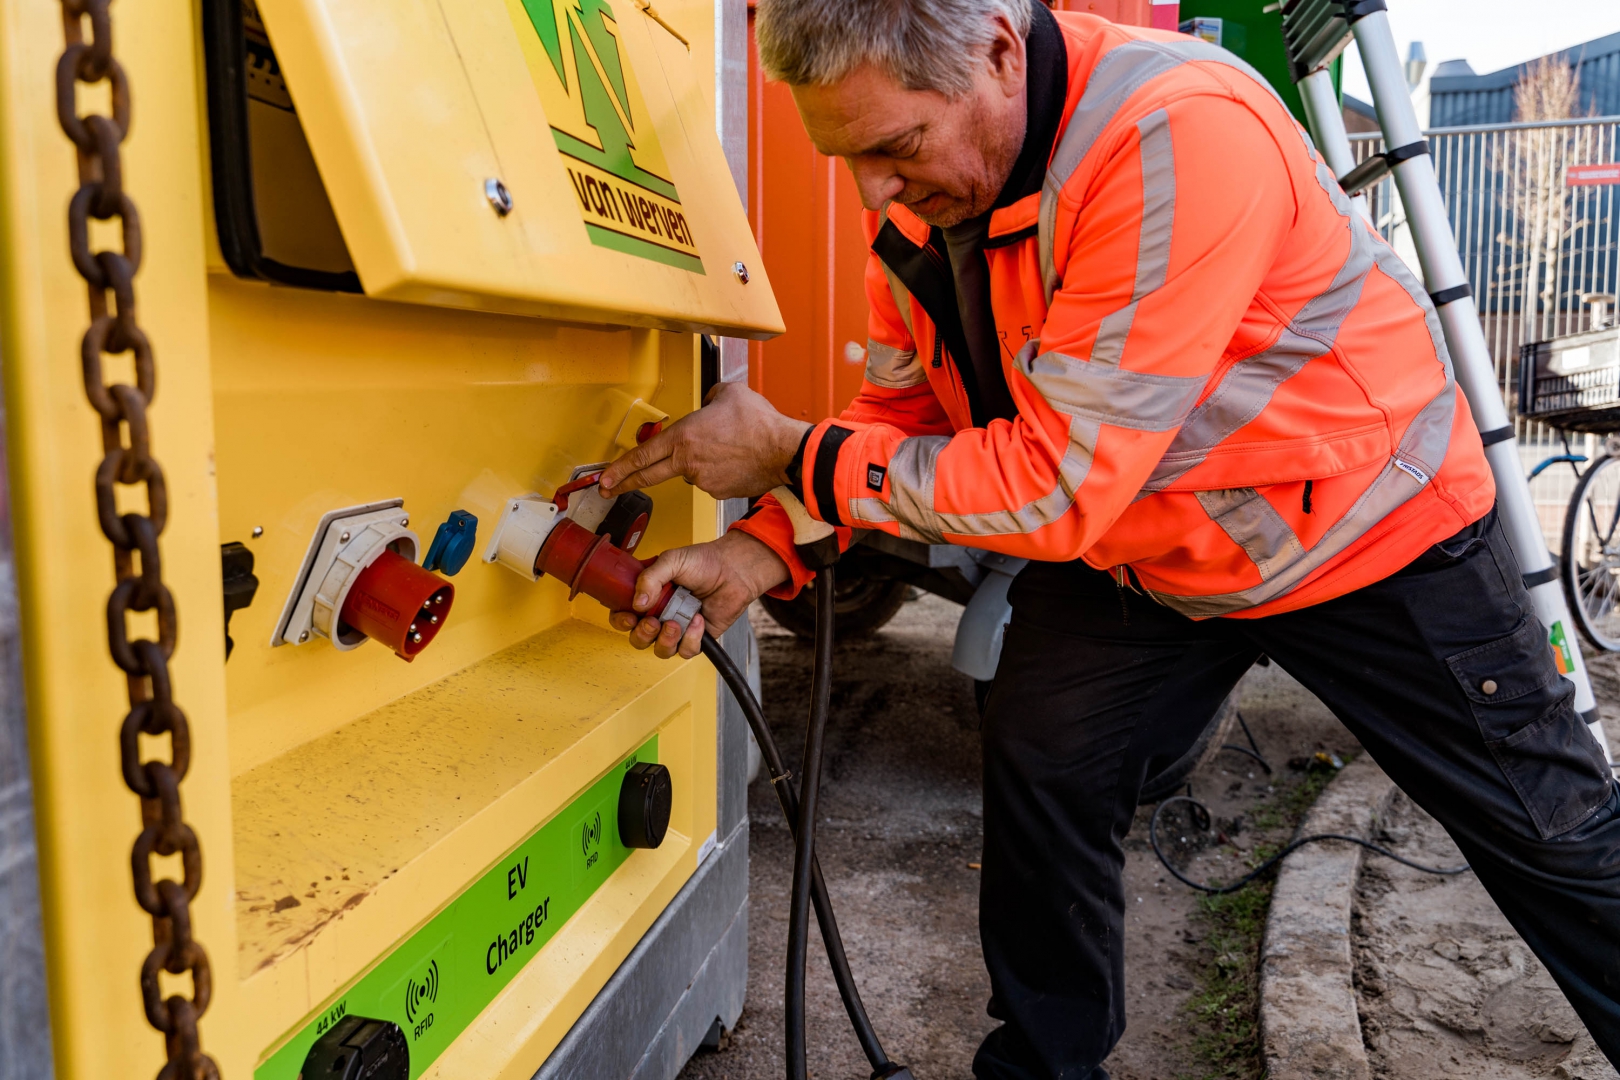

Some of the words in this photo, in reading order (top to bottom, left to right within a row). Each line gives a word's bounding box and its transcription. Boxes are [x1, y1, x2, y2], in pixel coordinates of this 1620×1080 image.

[567, 167, 624, 223] van
[508, 855, 529, 901] EV
[586, 851, 599, 870] RFID
[486, 896, 550, 975] Charger
[316, 1016, 329, 1036] 44
[331, 1000, 346, 1022] kW
[414, 1012, 434, 1041] RFID
